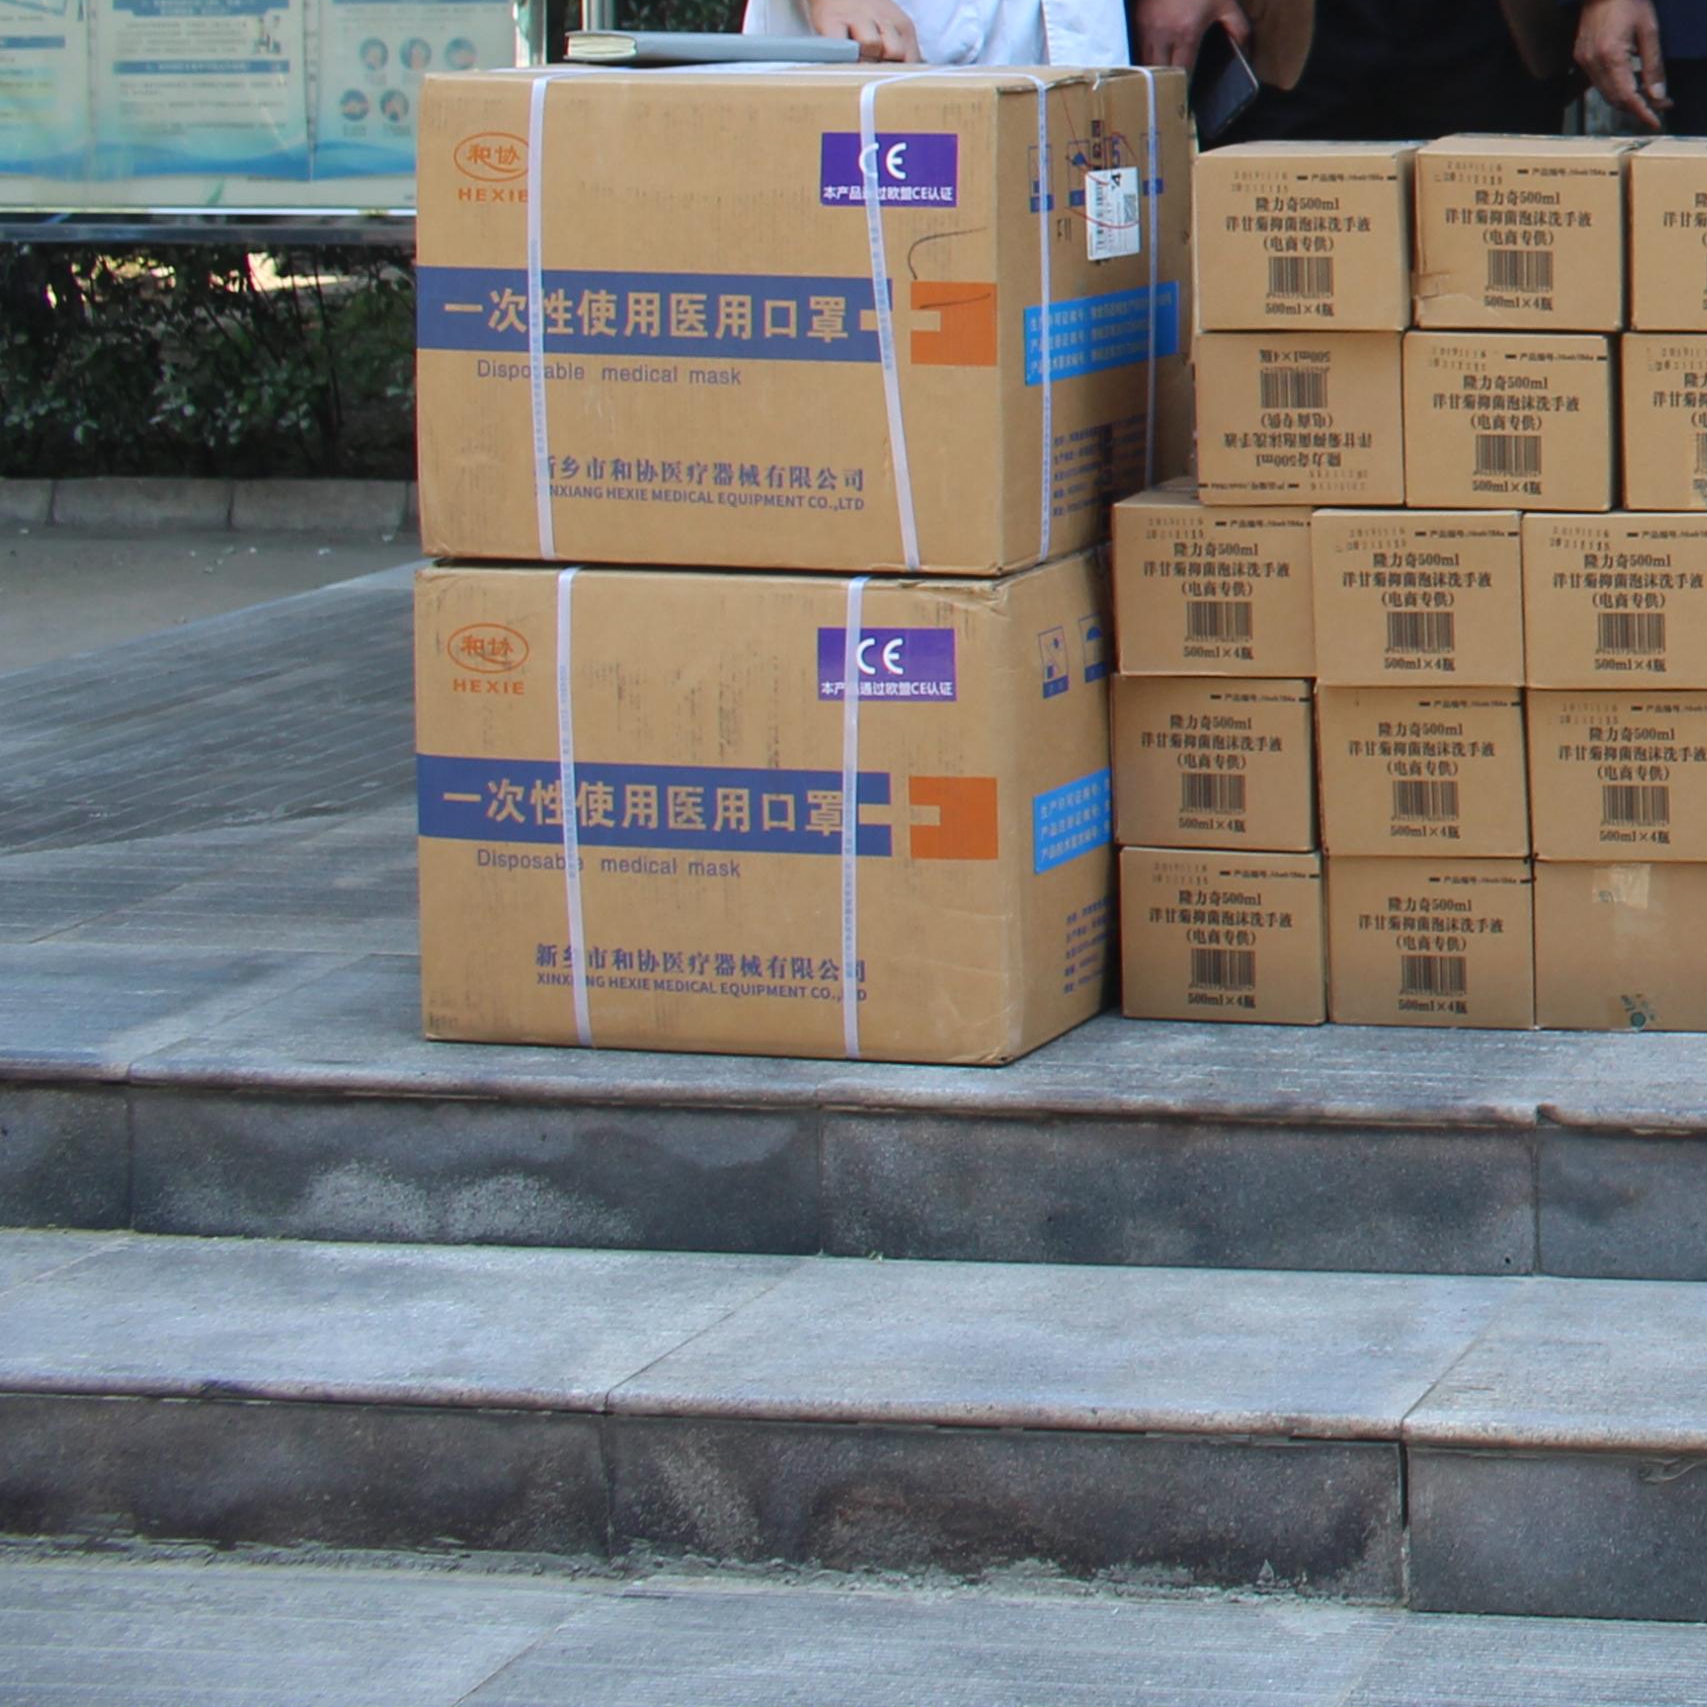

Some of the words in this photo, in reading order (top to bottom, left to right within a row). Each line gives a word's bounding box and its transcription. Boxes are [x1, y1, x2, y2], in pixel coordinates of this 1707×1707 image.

[823, 185, 953, 202] 本产品过欧盟CE认证
[444, 287, 849, 344] 一次性使用医用口罩
[477, 359, 584, 382] Dispoable
[602, 363, 678, 383] medical
[689, 366, 741, 385] mask
[607, 486, 647, 501] HEXIE
[652, 488, 713, 504] MEDICAL
[718, 491, 803, 509] EQUIPMENT
[855, 637, 904, 675] CE
[453, 679, 525, 696] HEXIE
[822, 679, 953, 697] 本产通过欧盟CE认证
[442, 778, 846, 838] 一次性使用医用口罩
[601, 854, 677, 875] medical
[687, 858, 741, 878] mask
[608, 976, 650, 992] HEXIE
[653, 979, 716, 995] MEDICAL
[720, 982, 807, 1000] EQUIPMENT
